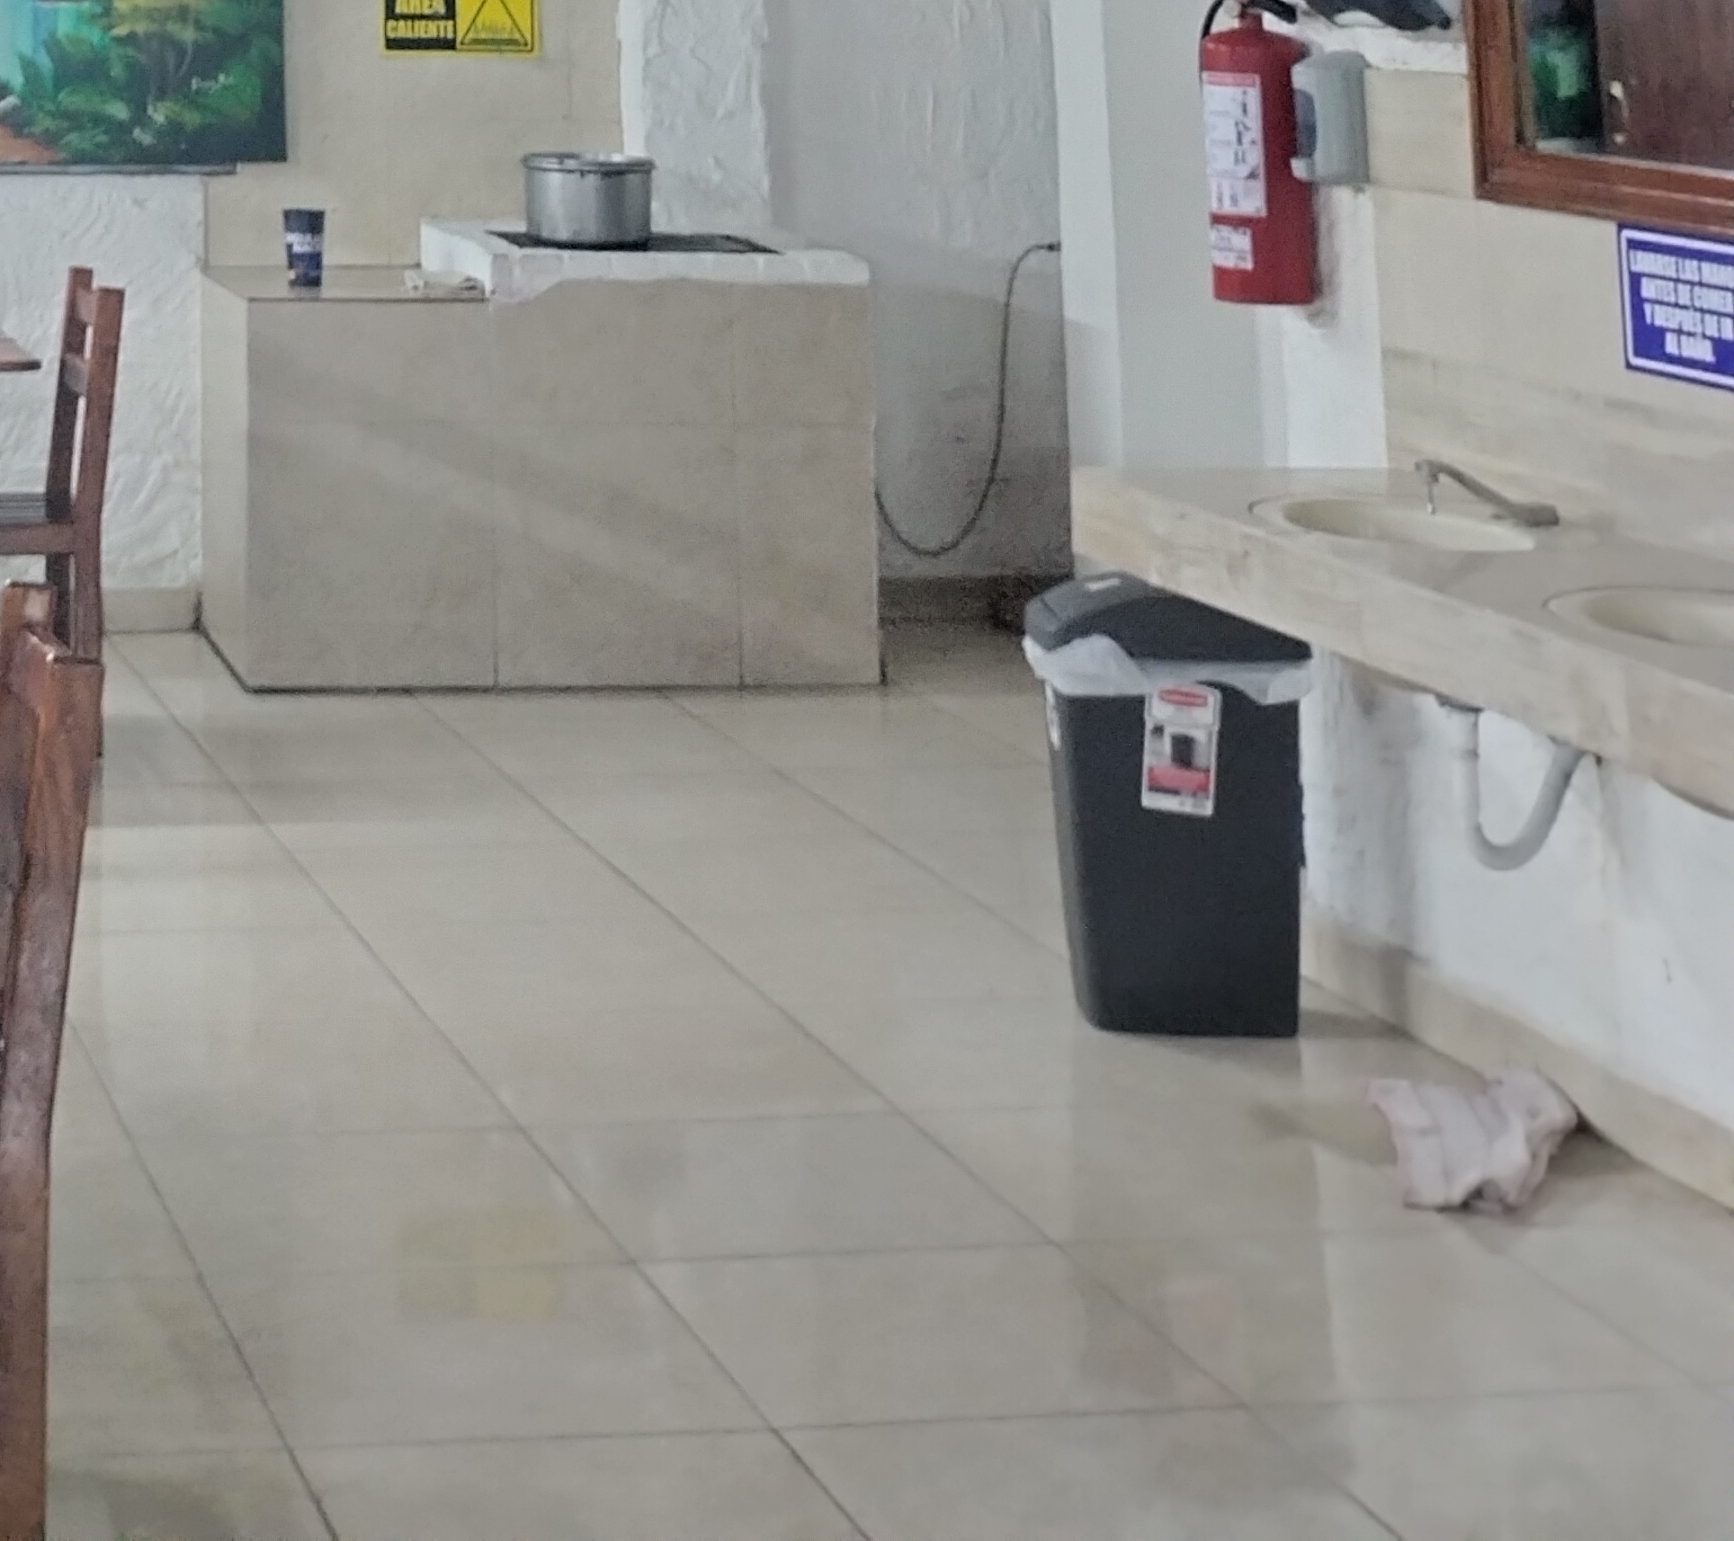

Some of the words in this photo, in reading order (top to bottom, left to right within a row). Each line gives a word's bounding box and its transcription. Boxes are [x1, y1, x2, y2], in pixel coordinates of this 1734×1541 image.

[386, 19, 454, 39] CALIENTE
[1677, 283, 1692, 306] DE
[1643, 302, 1653, 325] Y
[1704, 314, 1719, 338] DE
